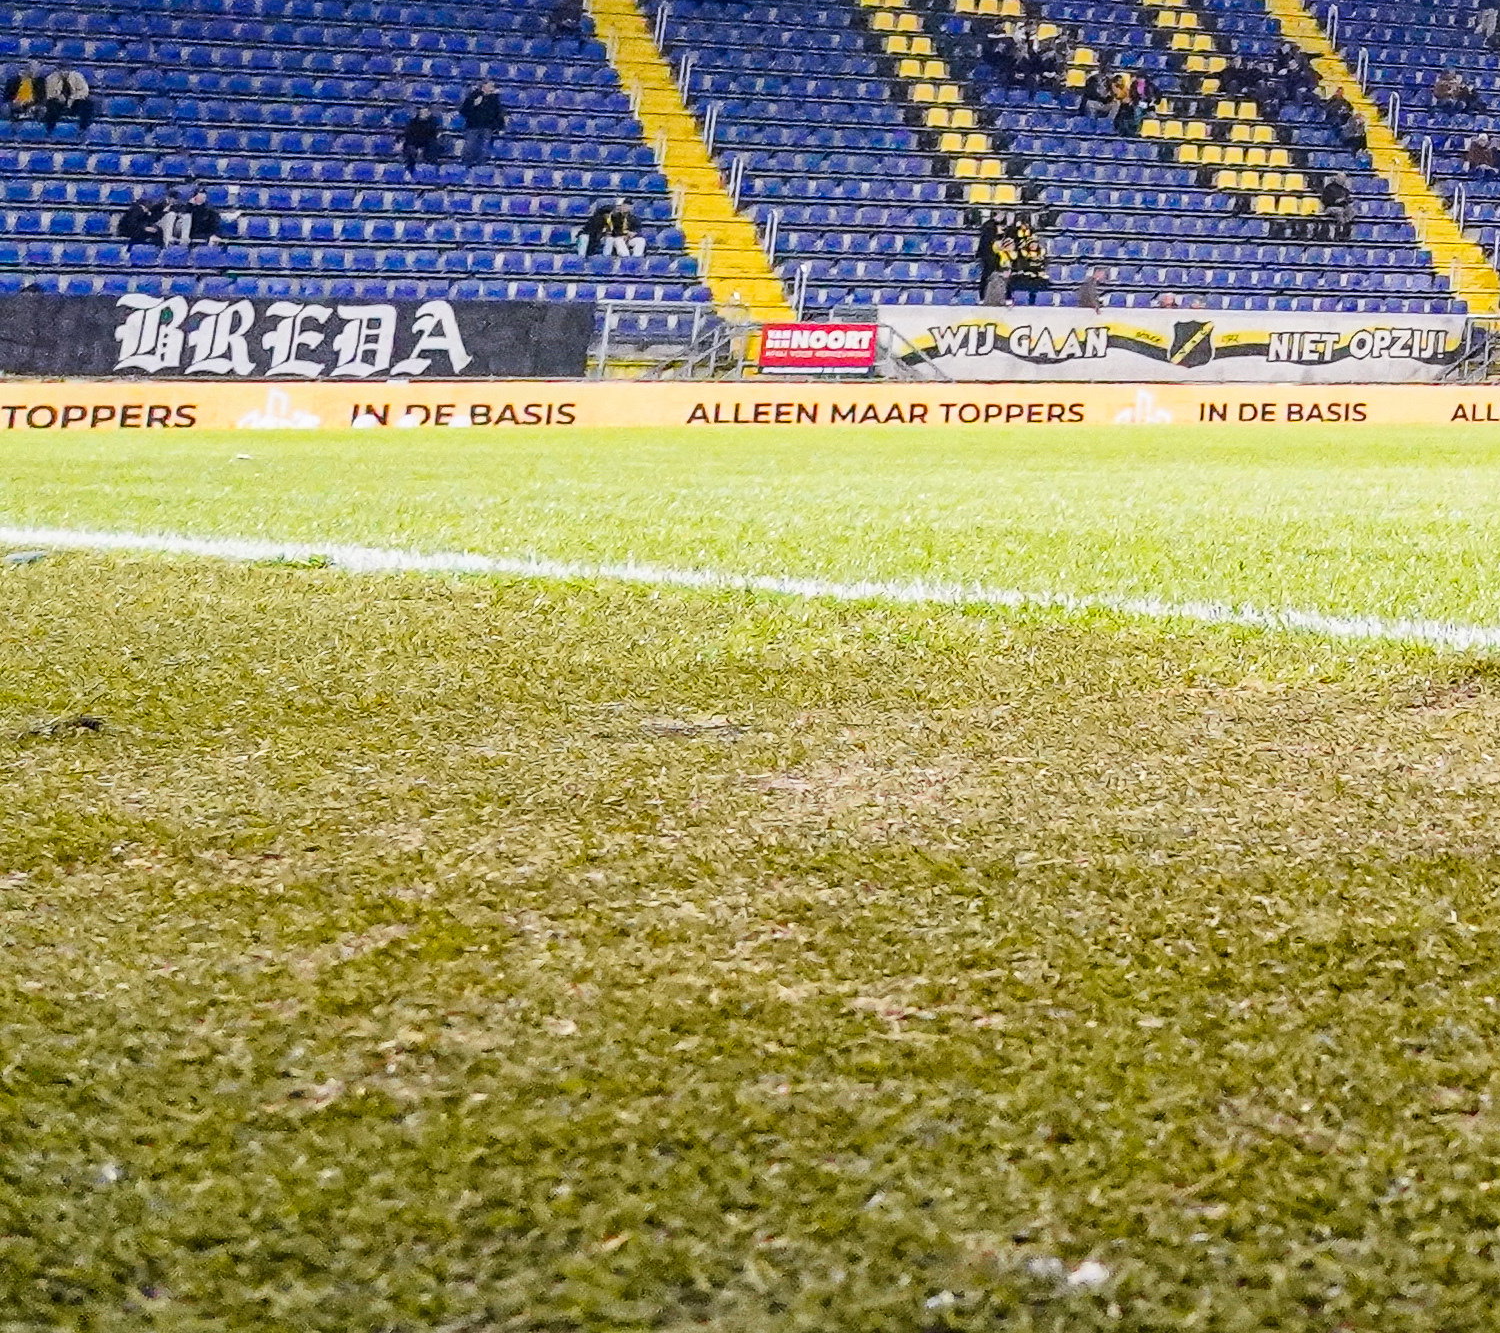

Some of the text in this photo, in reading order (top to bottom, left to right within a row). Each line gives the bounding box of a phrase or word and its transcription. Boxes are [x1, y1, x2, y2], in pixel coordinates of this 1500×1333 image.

[115, 293, 474, 378] BREDA
[790, 329, 873, 350] NOORT
[929, 324, 1447, 363] WIJ GAAN NIET OPZIJ!
[1, 404, 197, 429] TOPPERS
[470, 403, 577, 427] BASIS
[687, 401, 1085, 425] ALLEEN MAAR TOPPERS
[1199, 401, 1368, 424] IN DE BASIS
